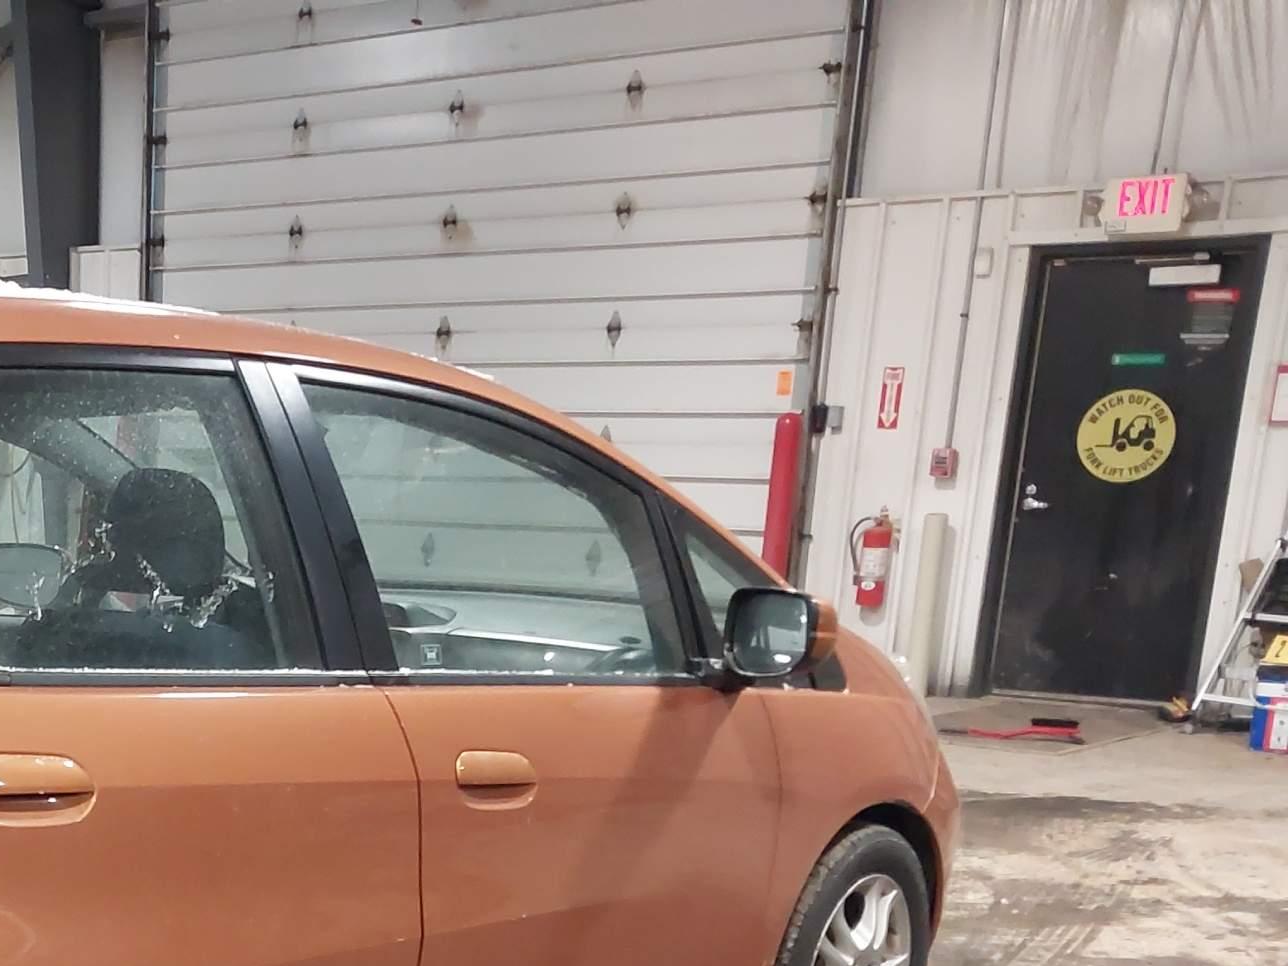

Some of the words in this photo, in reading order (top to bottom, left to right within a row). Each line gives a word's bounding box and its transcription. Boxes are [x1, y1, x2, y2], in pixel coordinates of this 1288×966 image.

[1118, 178, 1176, 217] EXIT
[1088, 395, 1125, 424] WATCH
[1128, 394, 1152, 407] OUT
[1150, 403, 1169, 424] FOR
[1084, 447, 1104, 470] FORK
[1102, 467, 1125, 478] LIFT
[1128, 447, 1164, 476] TRUCKS
